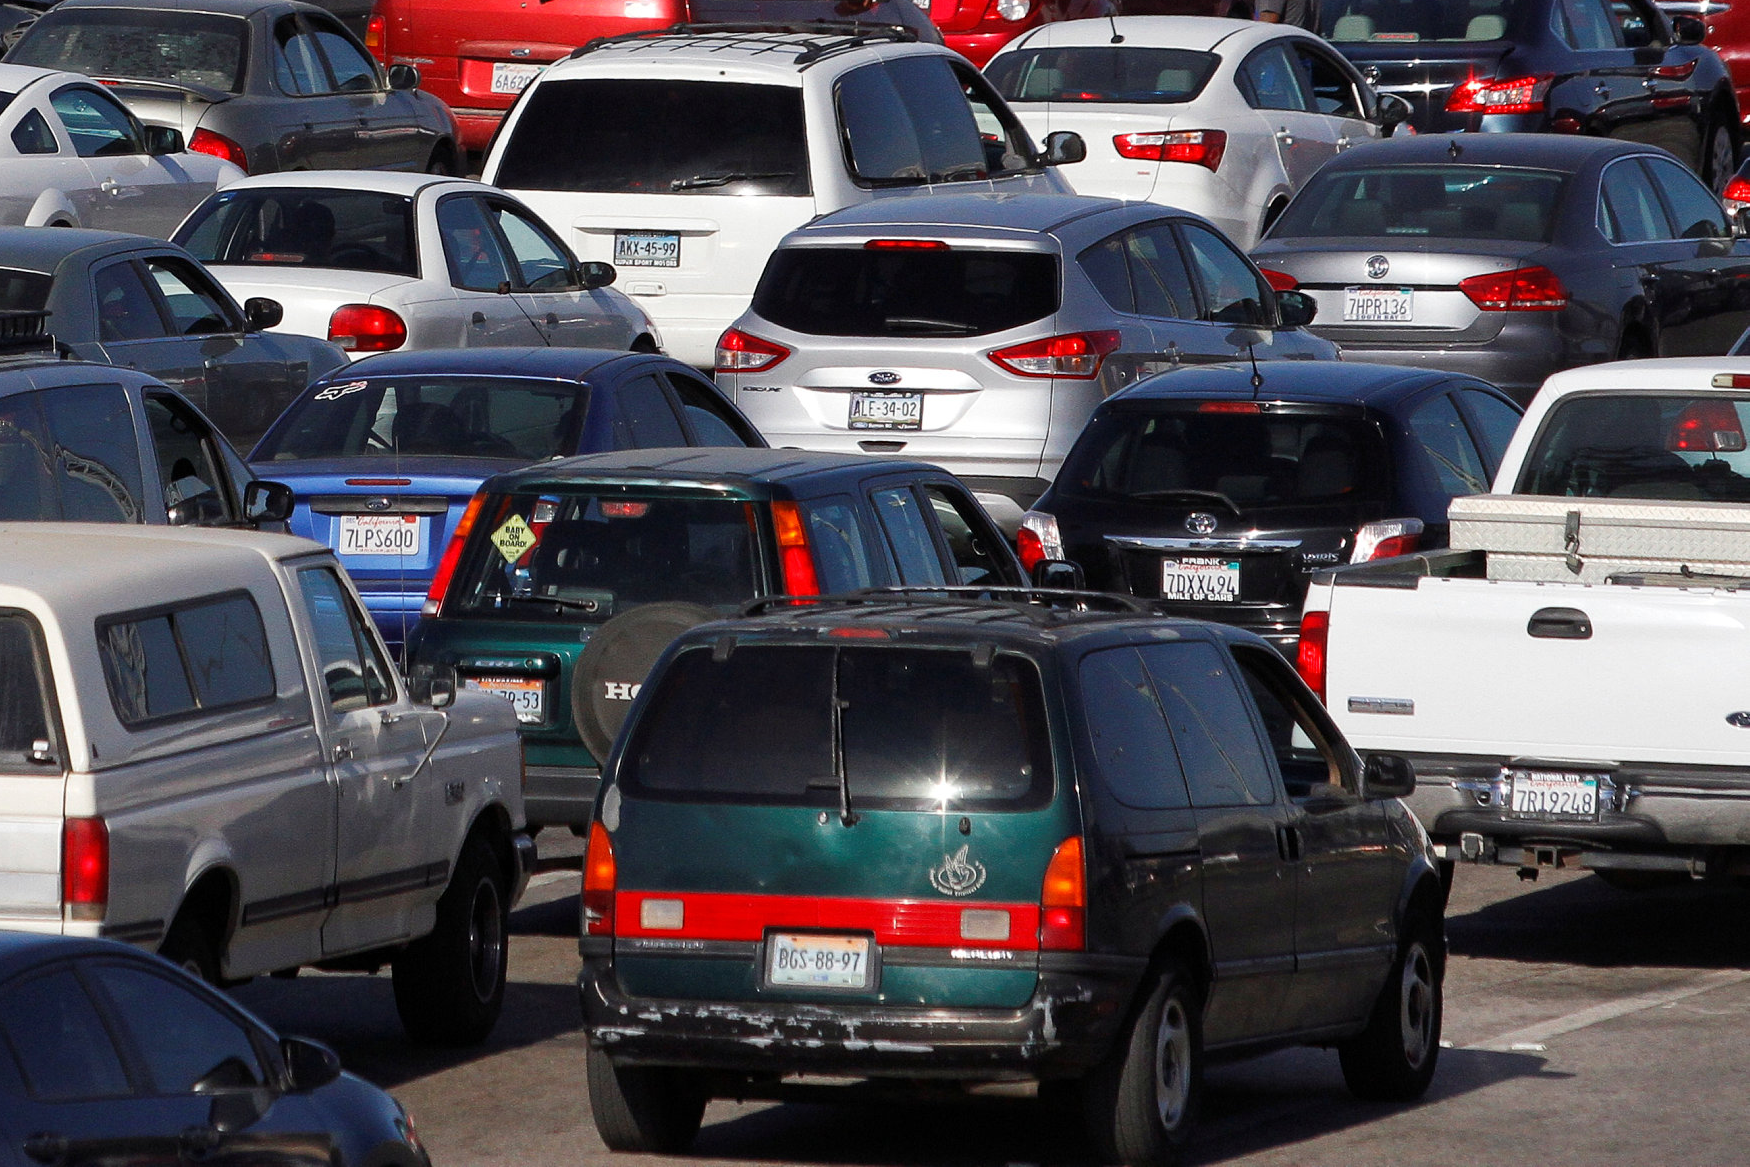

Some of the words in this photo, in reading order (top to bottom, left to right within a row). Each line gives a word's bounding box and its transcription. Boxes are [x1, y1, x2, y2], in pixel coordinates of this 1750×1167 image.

[619, 240, 676, 256] AKX-45-99
[1349, 298, 1408, 316] 7HPR136
[853, 400, 917, 417] ALE-34-02
[357, 515, 402, 529] California
[505, 526, 525, 534] BABY
[346, 529, 414, 549] 7LPS600
[500, 539, 527, 548] BOARD!
[509, 533, 520, 541] ON
[1182, 558, 1220, 566] FRANK
[1166, 572, 1236, 594] 7DXX494
[1192, 593, 1207, 601] OF
[1207, 594, 1234, 602] CARS
[1516, 789, 1593, 814] 7R19248
[778, 947, 861, 971] BGS-88-97
